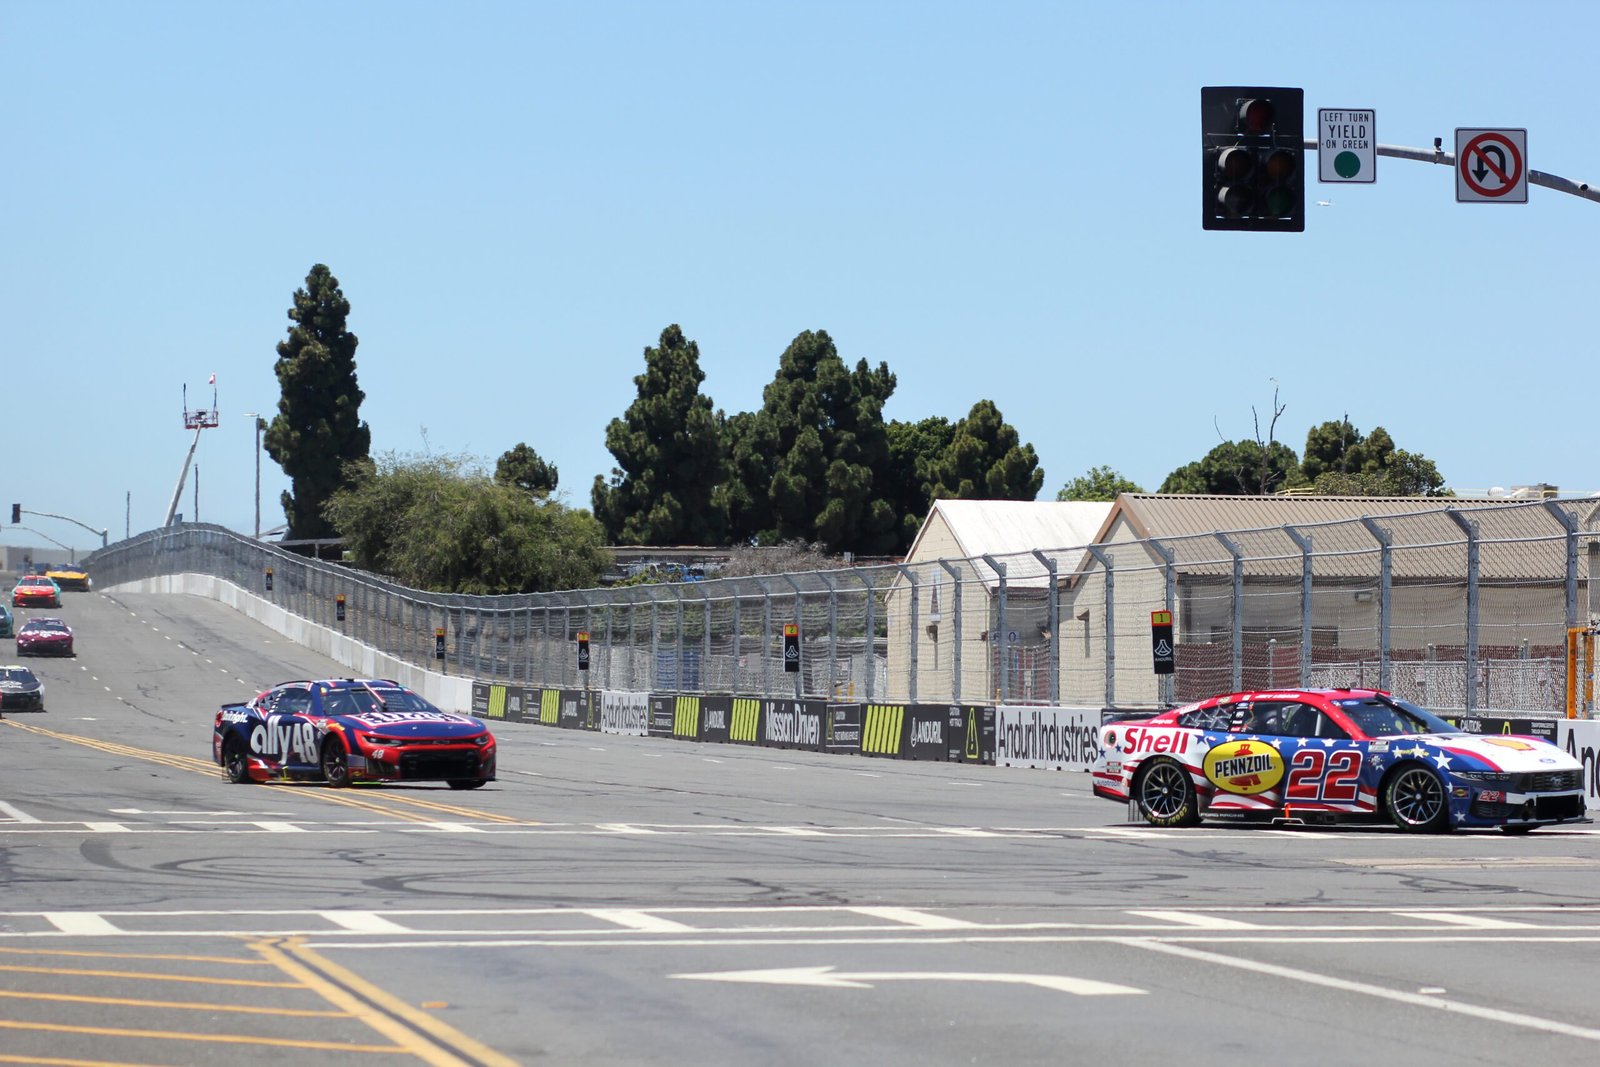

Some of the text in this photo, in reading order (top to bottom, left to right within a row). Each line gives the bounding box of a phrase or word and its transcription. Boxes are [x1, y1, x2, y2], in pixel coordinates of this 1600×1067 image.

[1325, 113, 1369, 122] LEFT TURN
[1329, 125, 1366, 139] YIELD
[1326, 140, 1369, 149] ON GREEN
[1160, 613, 1164, 623] 1
[765, 702, 820, 745] Mission Driven
[917, 720, 943, 744] ANDURIL
[250, 715, 320, 766] ally 48
[998, 711, 1037, 760] Anduril
[1038, 711, 1099, 764] Industries
[1123, 728, 1190, 755] Shell
[371, 749, 385, 759] 48
[1214, 754, 1273, 779] PENNZOIL
[1284, 749, 1364, 801] 22
[1478, 789, 1500, 802] 22
